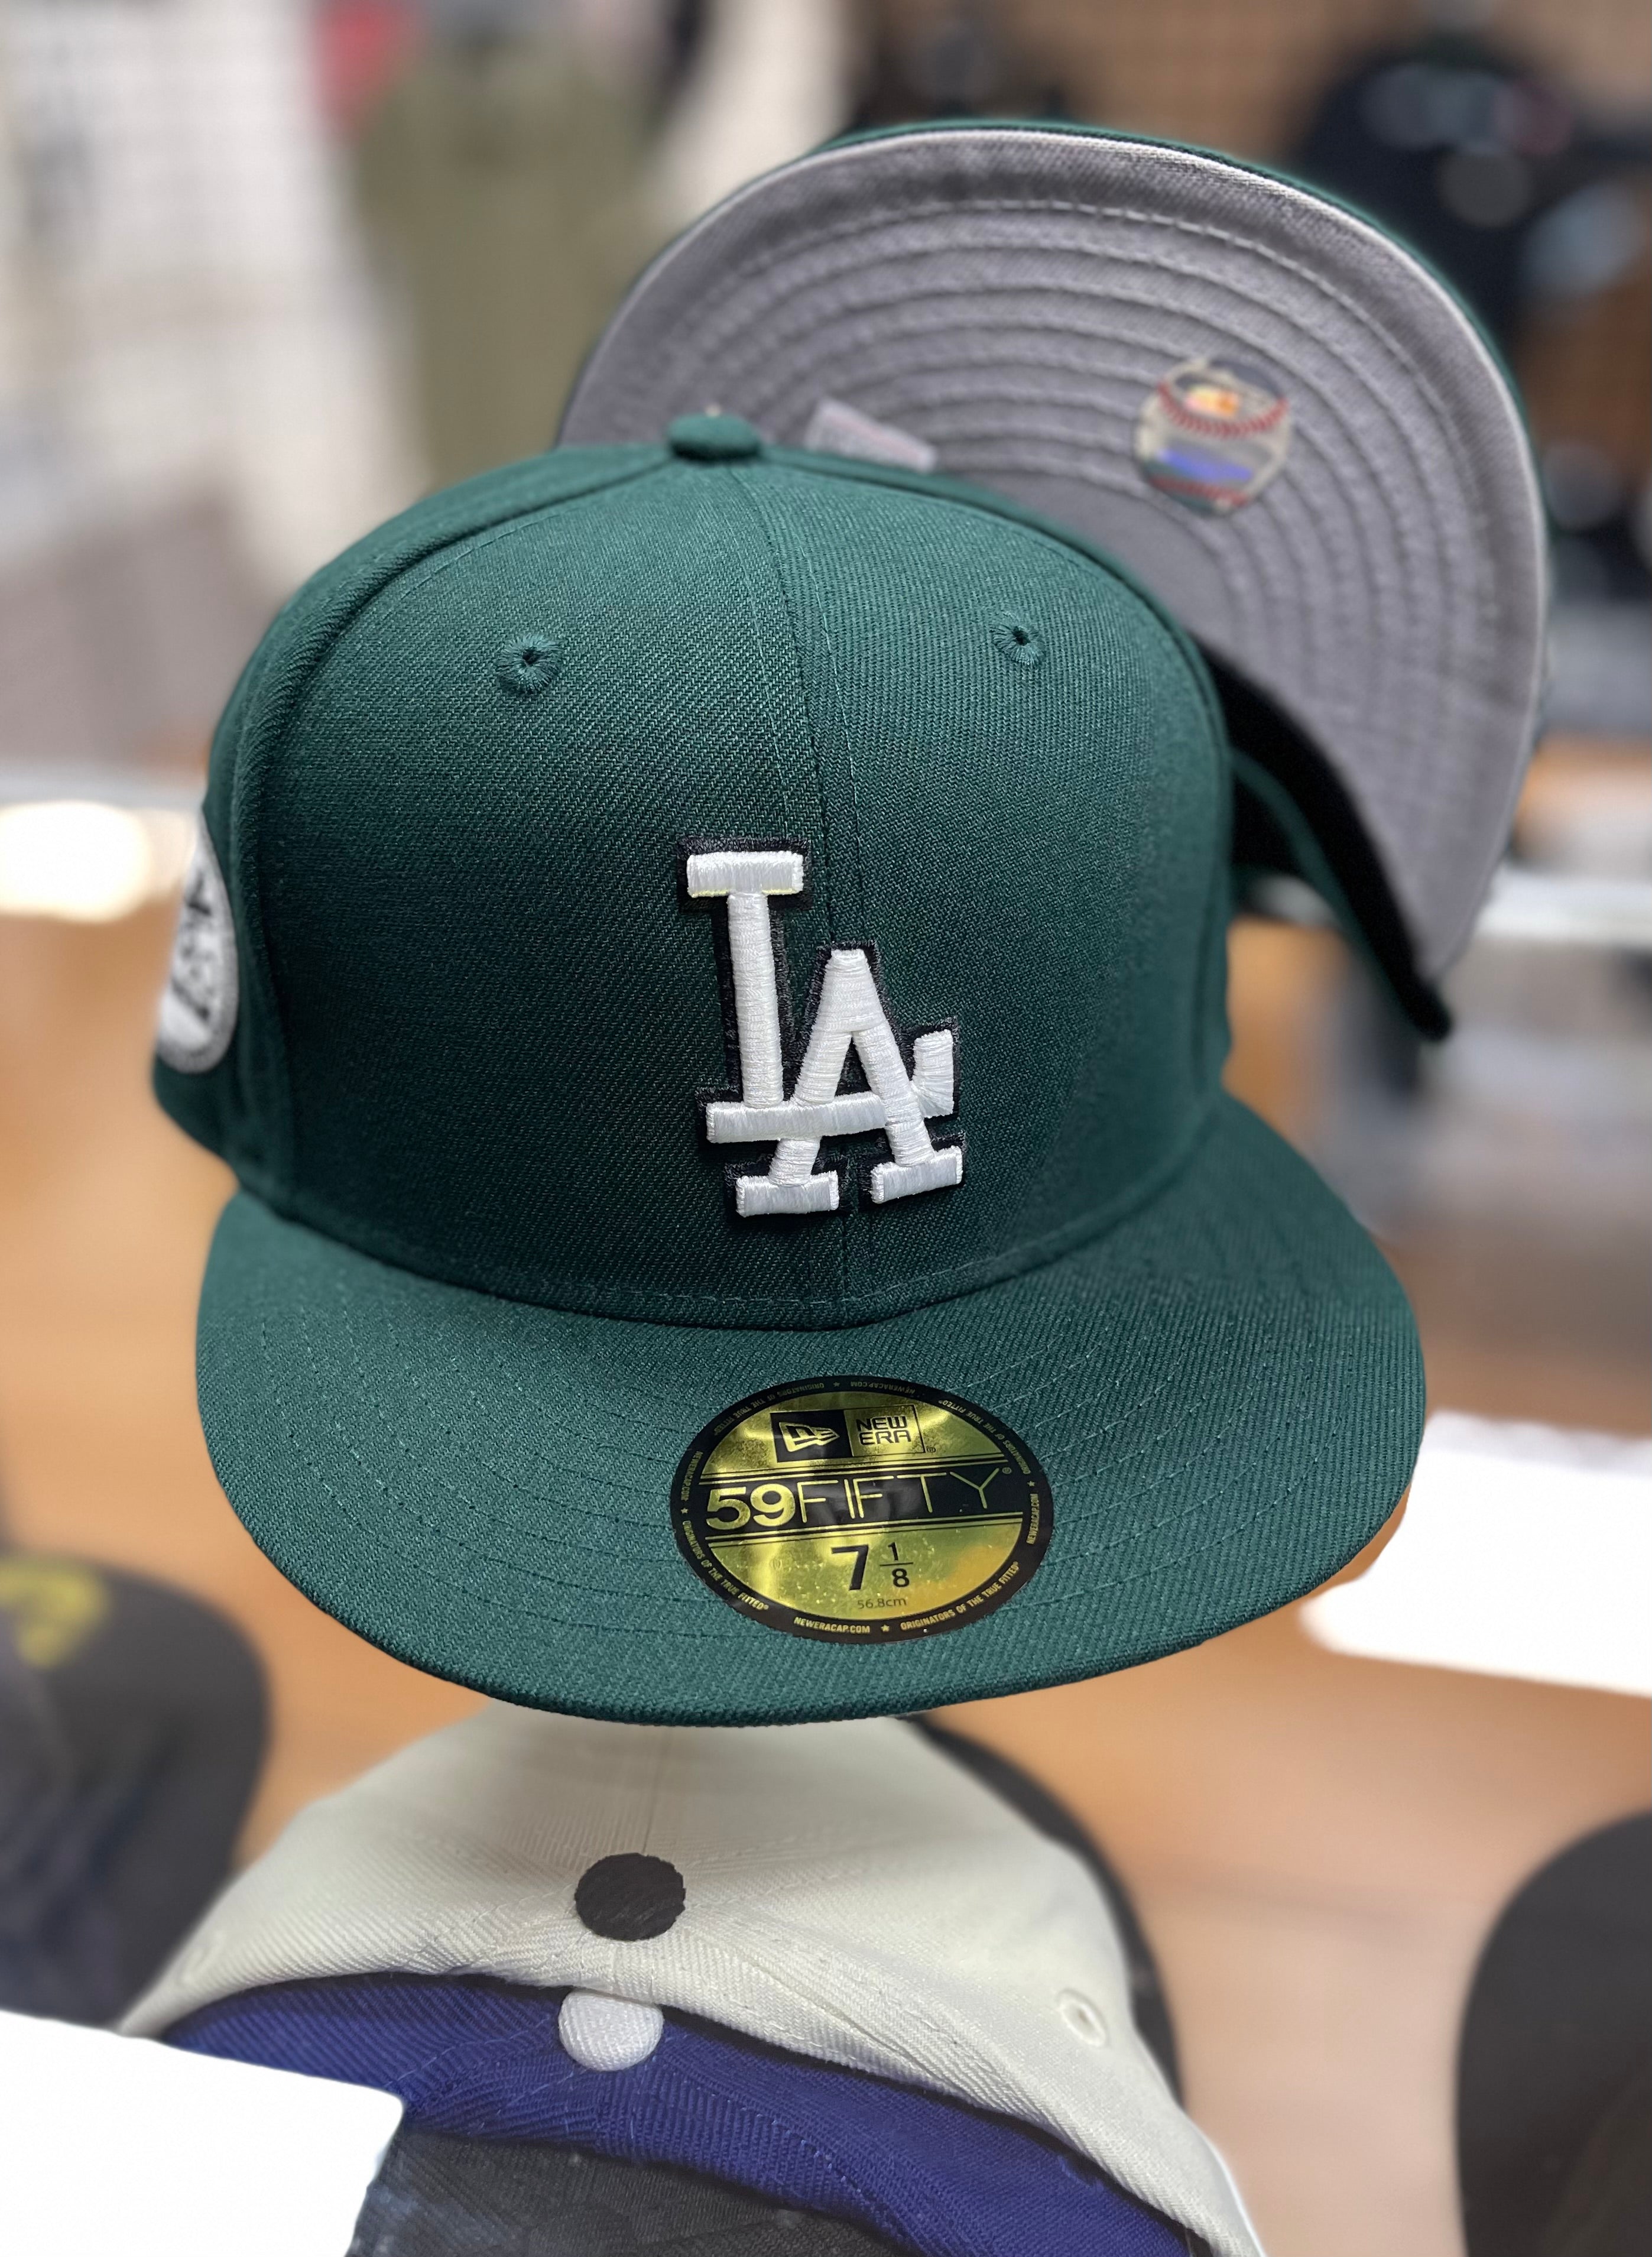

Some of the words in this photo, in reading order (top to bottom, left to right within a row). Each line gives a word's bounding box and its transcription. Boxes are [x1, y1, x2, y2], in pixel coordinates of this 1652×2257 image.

[686, 850, 963, 1217] LA
[856, 1415, 907, 1431] NEW
[966, 1410, 984, 1424] TRUE
[983, 1422, 997, 1434] THE
[859, 1429, 911, 1445] ERA
[706, 1468, 999, 1530] 59FIFTY
[831, 1544, 869, 1591] 7
[709, 1568, 723, 1581] THE
[720, 1579, 739, 1595] TRUE
[858, 1598, 907, 1609] 56.8cm
[900, 1609, 956, 1630] ORIGINATORS
[956, 1603, 967, 1614] OF
[966, 1595, 984, 1607] THE
[981, 1582, 1002, 1597] TRUE
[794, 1617, 870, 1634] NEWERACAP.COM
